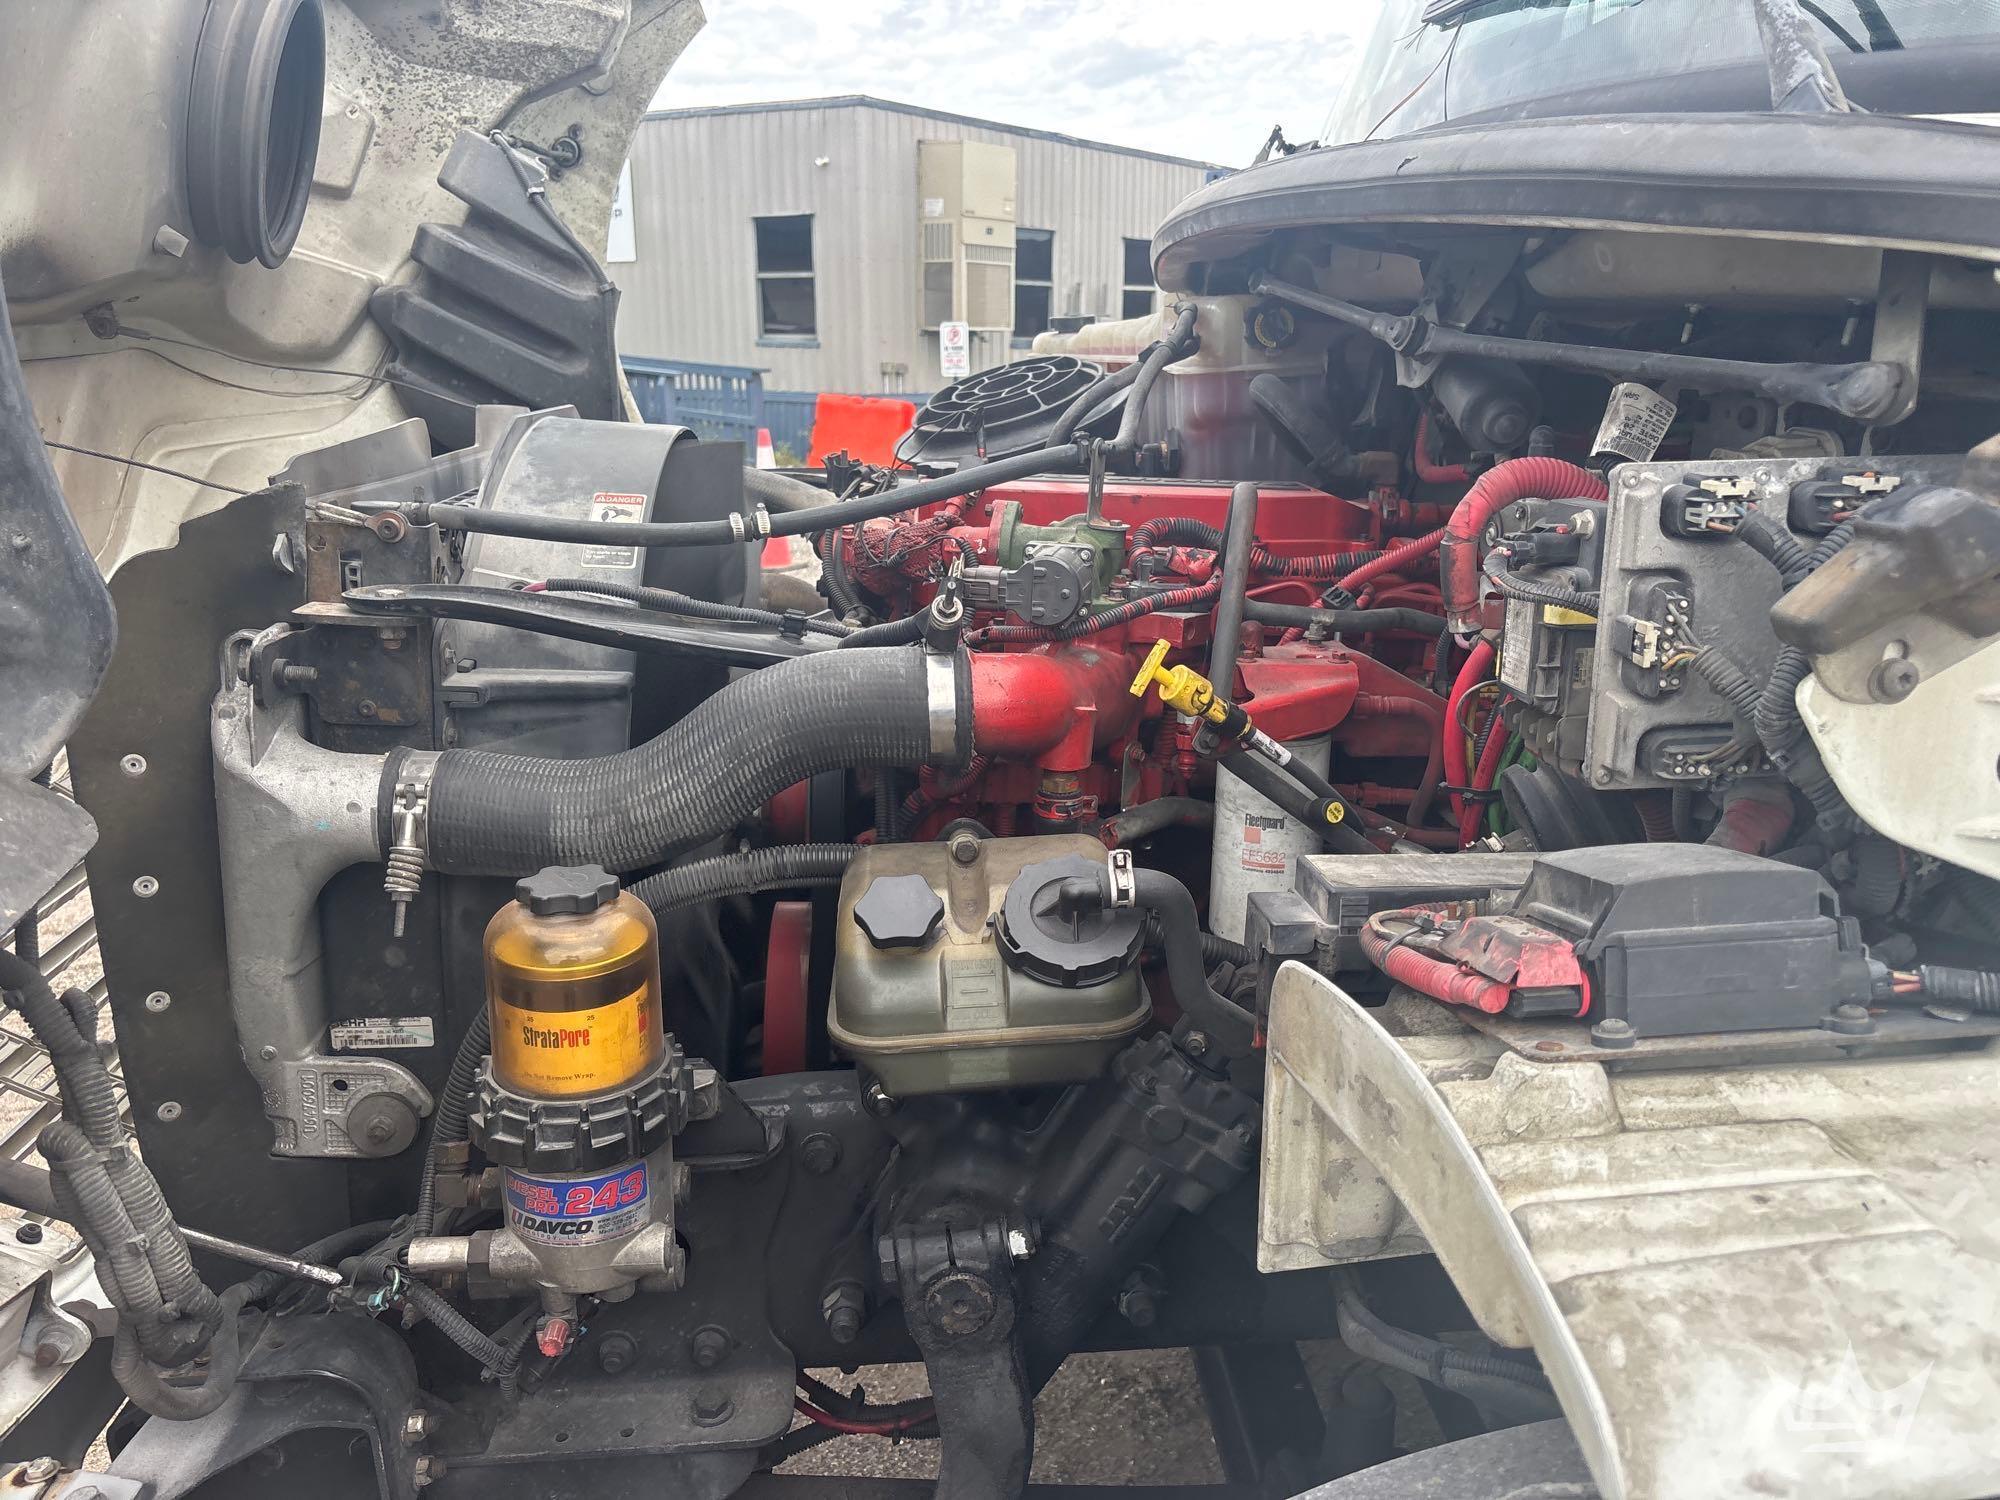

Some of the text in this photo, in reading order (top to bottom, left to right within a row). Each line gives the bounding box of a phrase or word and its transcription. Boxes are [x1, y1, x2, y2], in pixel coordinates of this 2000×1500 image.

[606, 496, 643, 504] DANGER
[1245, 813, 1285, 831] Fleetguard
[1242, 848, 1286, 863] FF5632
[526, 1014, 595, 1023] 25 25
[522, 1025, 590, 1049] StrataPore
[573, 1072, 596, 1081] Wrap.
[506, 1174, 558, 1202] DIESEL
[525, 1169, 645, 1217] PRO 243
[522, 1216, 594, 1236] DAVCO
